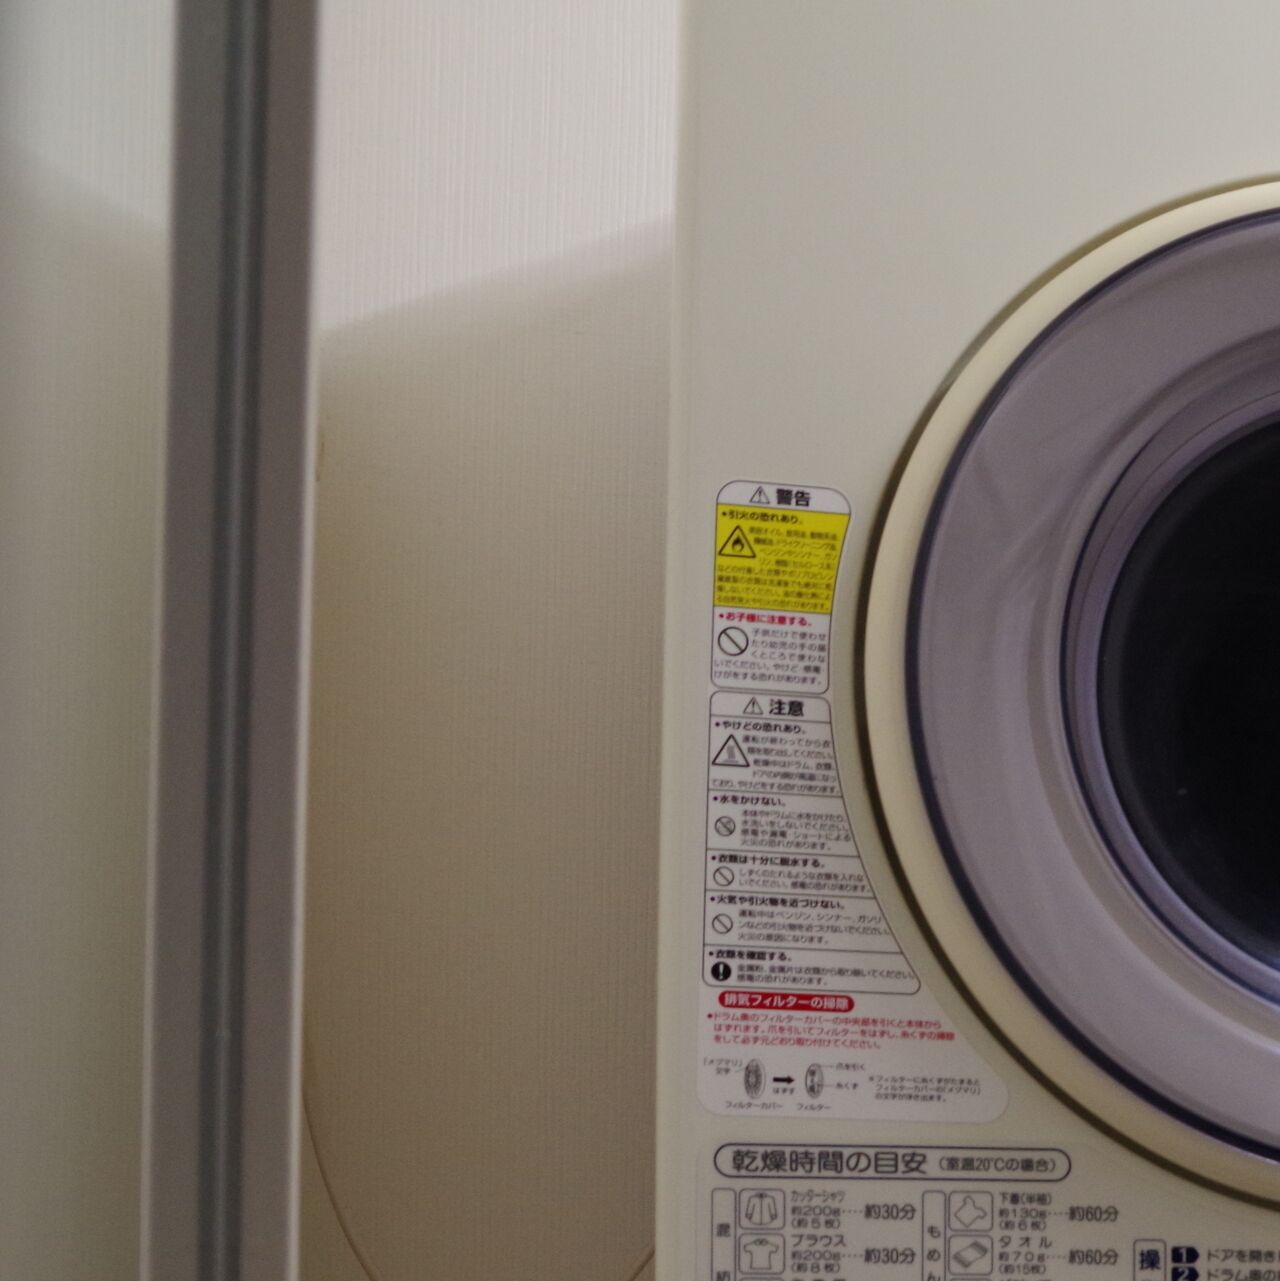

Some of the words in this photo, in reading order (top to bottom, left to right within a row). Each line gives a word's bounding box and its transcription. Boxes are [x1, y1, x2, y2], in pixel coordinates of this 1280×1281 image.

[776, 488, 810, 507] 警告
[769, 699, 804, 717] 注意
[731, 1149, 928, 1175] 乾燥時間の目安
[864, 1204, 917, 1221] 約30分
[1068, 1206, 1119, 1223] 約60分
[790, 1234, 847, 1247] ブラウス
[864, 1248, 916, 1265] 約30分
[1068, 1250, 1118, 1266] 約60分
